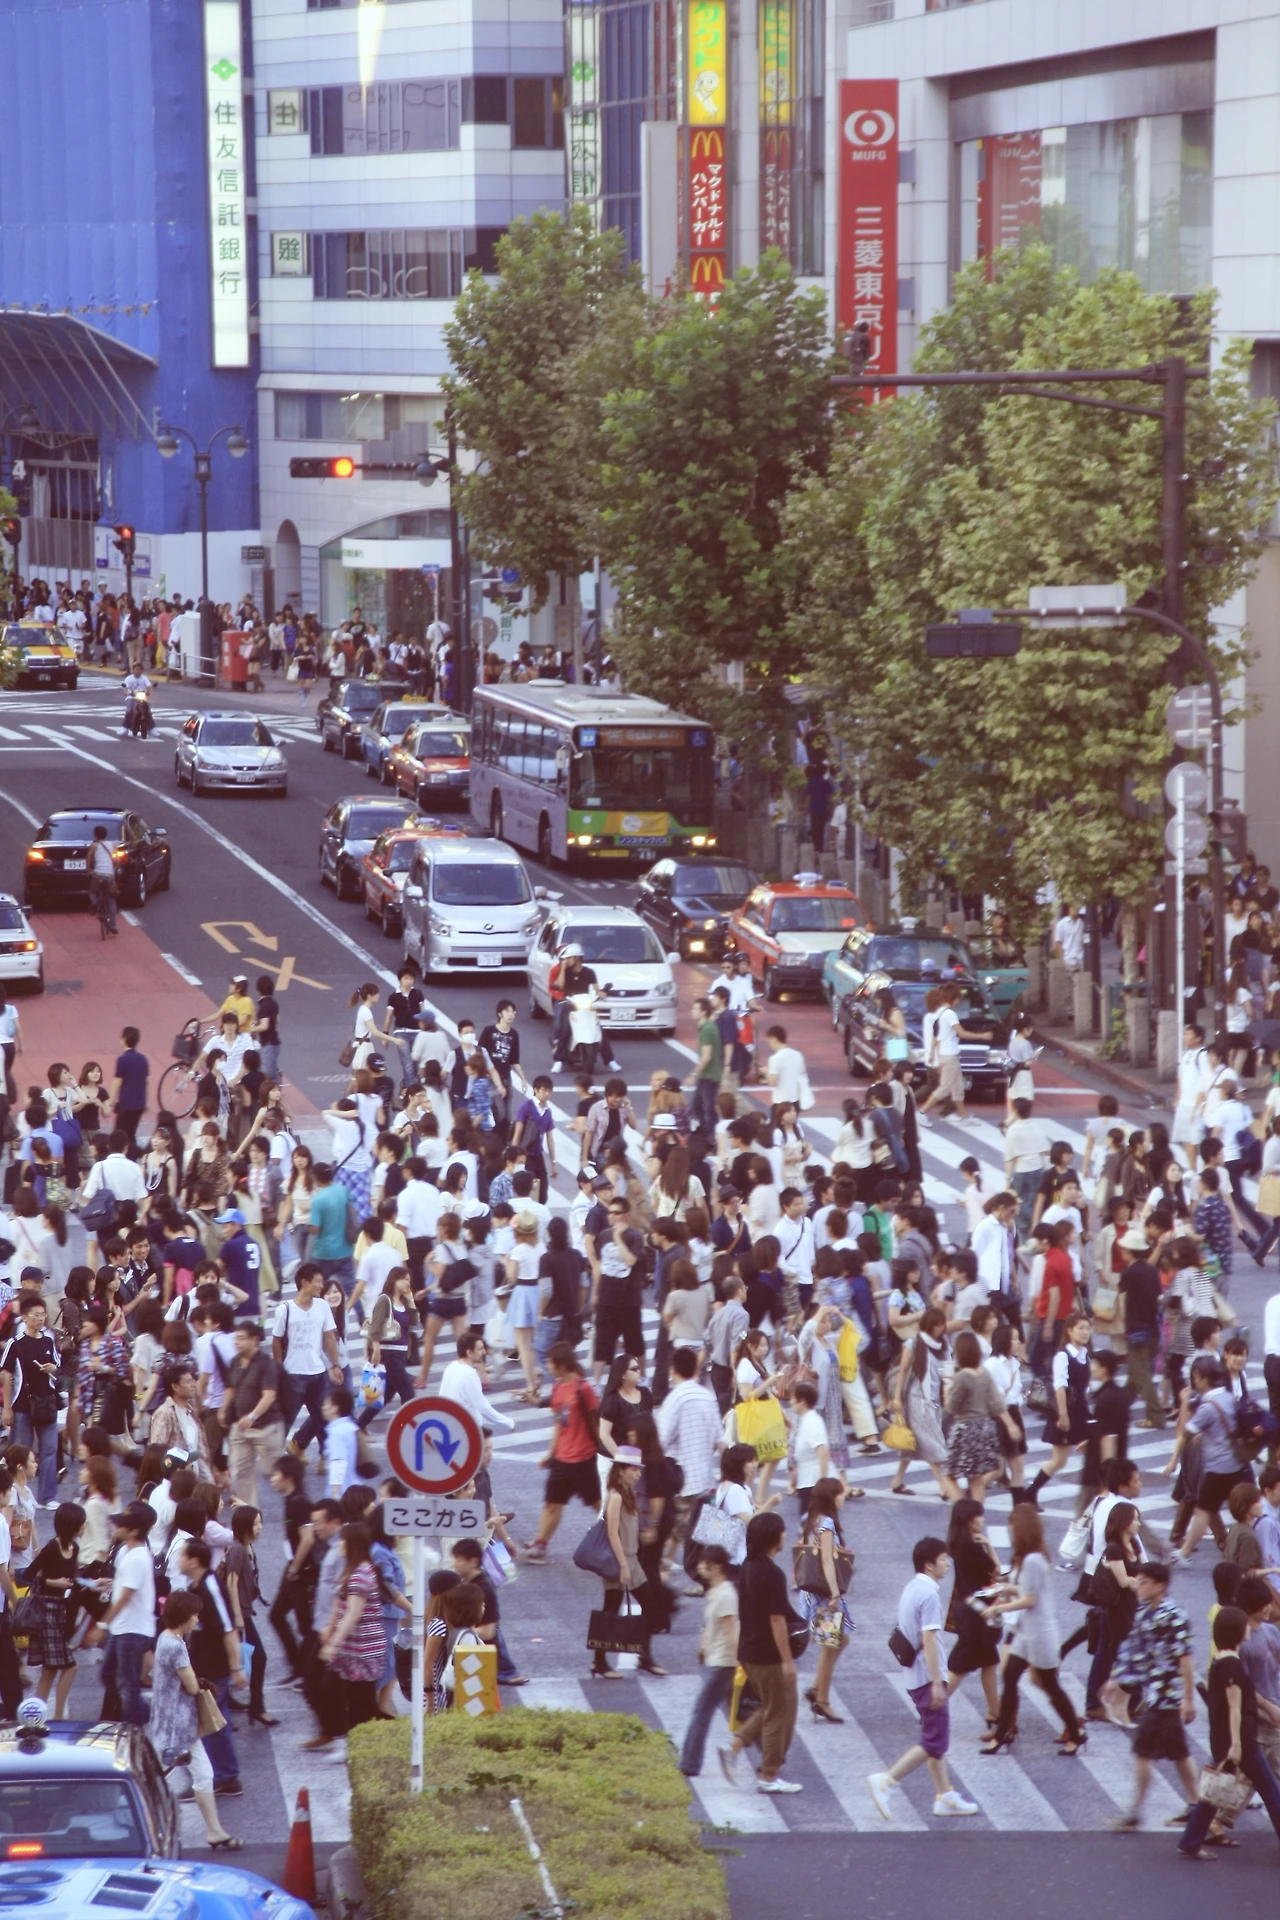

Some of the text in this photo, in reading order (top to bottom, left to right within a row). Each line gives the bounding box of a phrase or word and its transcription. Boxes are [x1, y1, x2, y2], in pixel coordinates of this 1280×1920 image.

[852, 151, 886, 160] MUFG
[214, 101, 241, 294] 住友信託銀行
[692, 173, 708, 246] ハンバーガー
[707, 164, 723, 242] マクドナルド
[245, 1243, 260, 1269] 3
[391, 1508, 478, 1529] ここから
